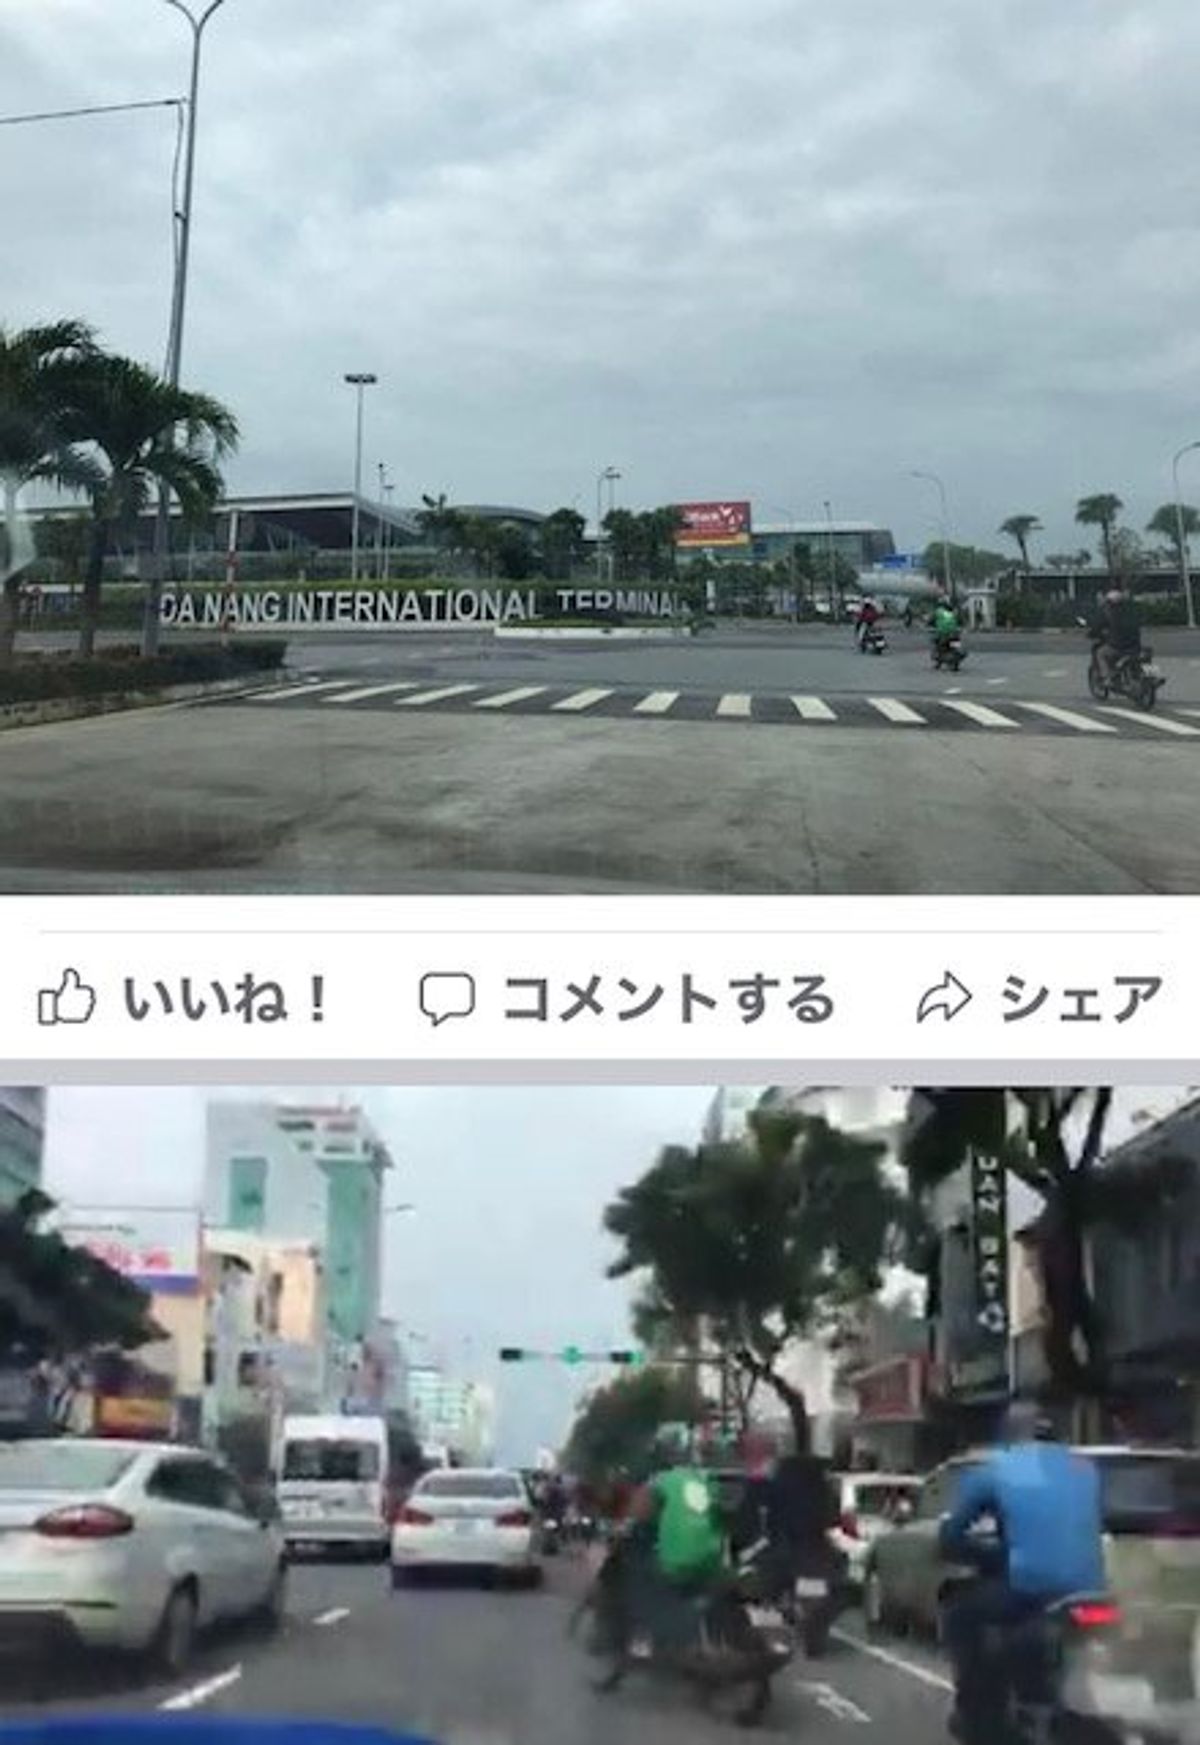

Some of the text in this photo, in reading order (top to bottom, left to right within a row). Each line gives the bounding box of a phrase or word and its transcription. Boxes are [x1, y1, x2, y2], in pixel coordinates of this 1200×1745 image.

[160, 588, 682, 625] DA NANG INTERNATIONAL TERMINAL
